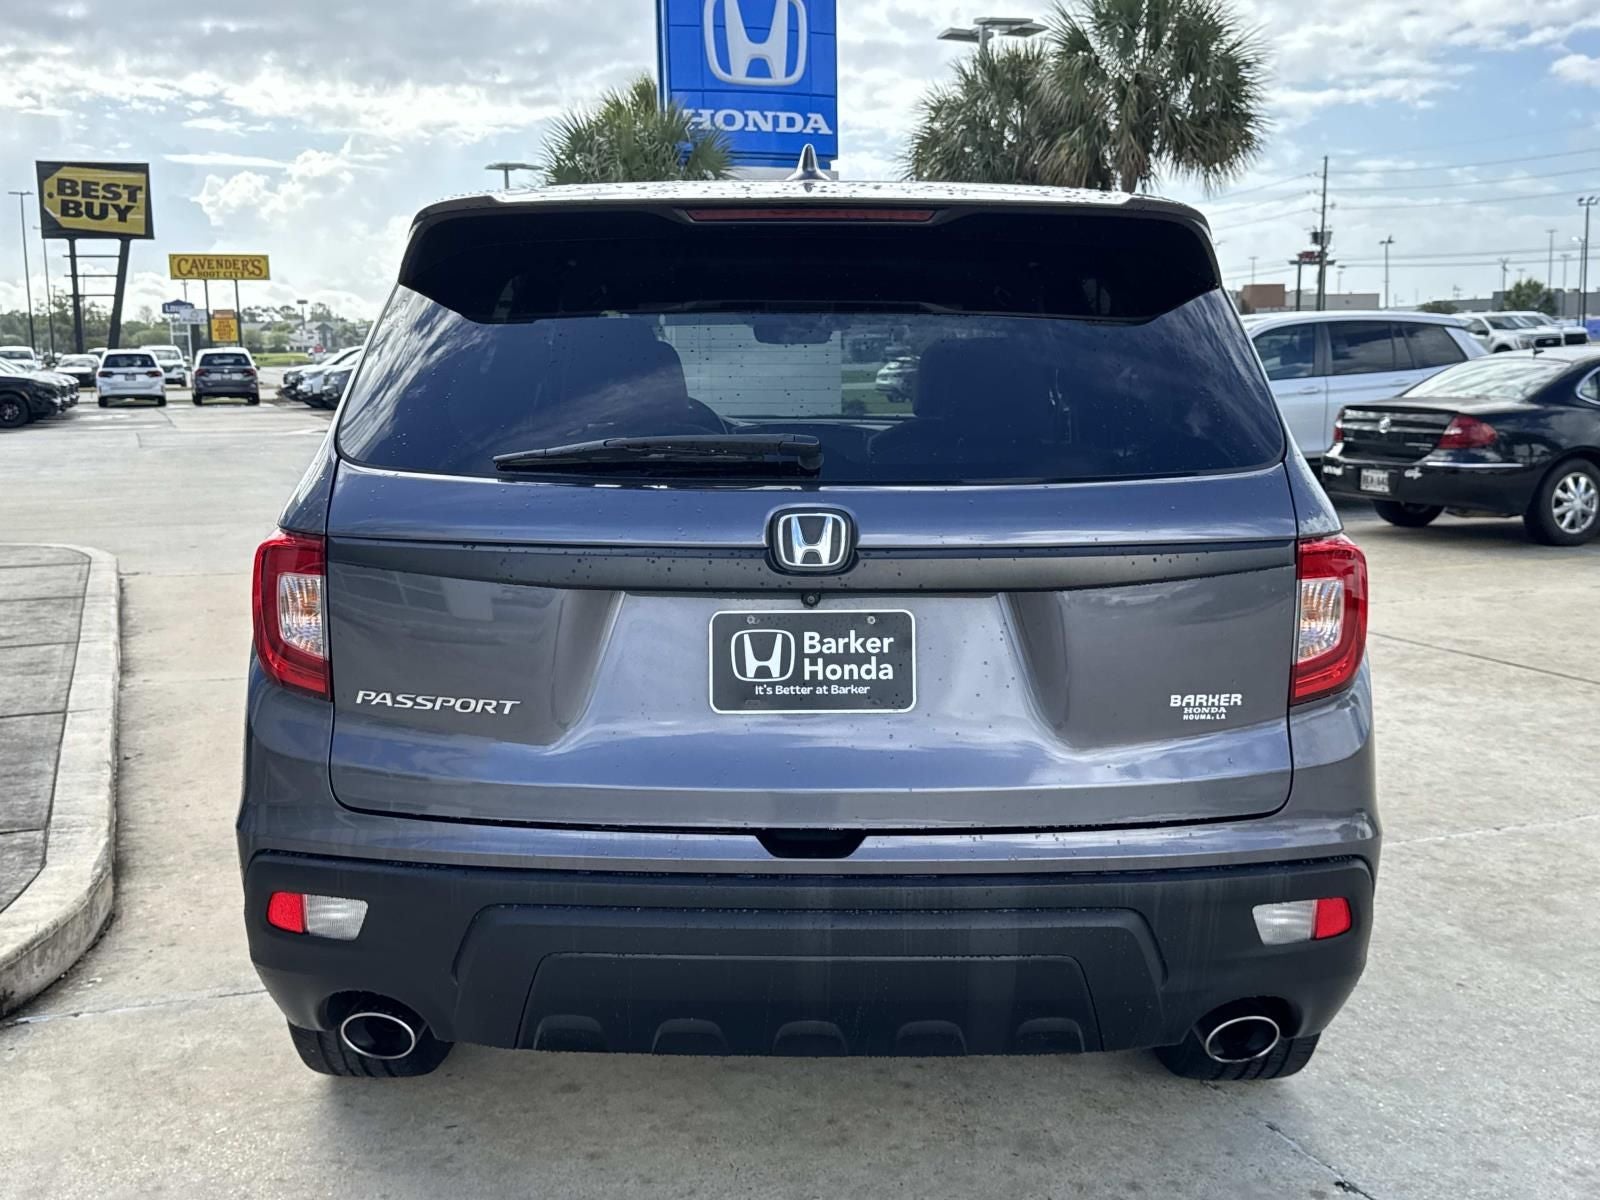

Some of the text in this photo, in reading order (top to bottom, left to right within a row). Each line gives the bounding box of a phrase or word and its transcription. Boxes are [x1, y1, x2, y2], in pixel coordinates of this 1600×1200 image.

[682, 108, 833, 135] HONDA
[57, 178, 143, 203] BEST
[60, 199, 136, 223] BUY
[177, 257, 263, 276] CAVENDER'S
[223, 270, 245, 278] CITY
[804, 630, 894, 654] Barker
[804, 656, 894, 680] Honda
[755, 684, 870, 695] It's Better at Barker
[1169, 693, 1243, 707] BARKER
[355, 690, 521, 715] PASSPORT
[1183, 706, 1227, 714] HONDA
